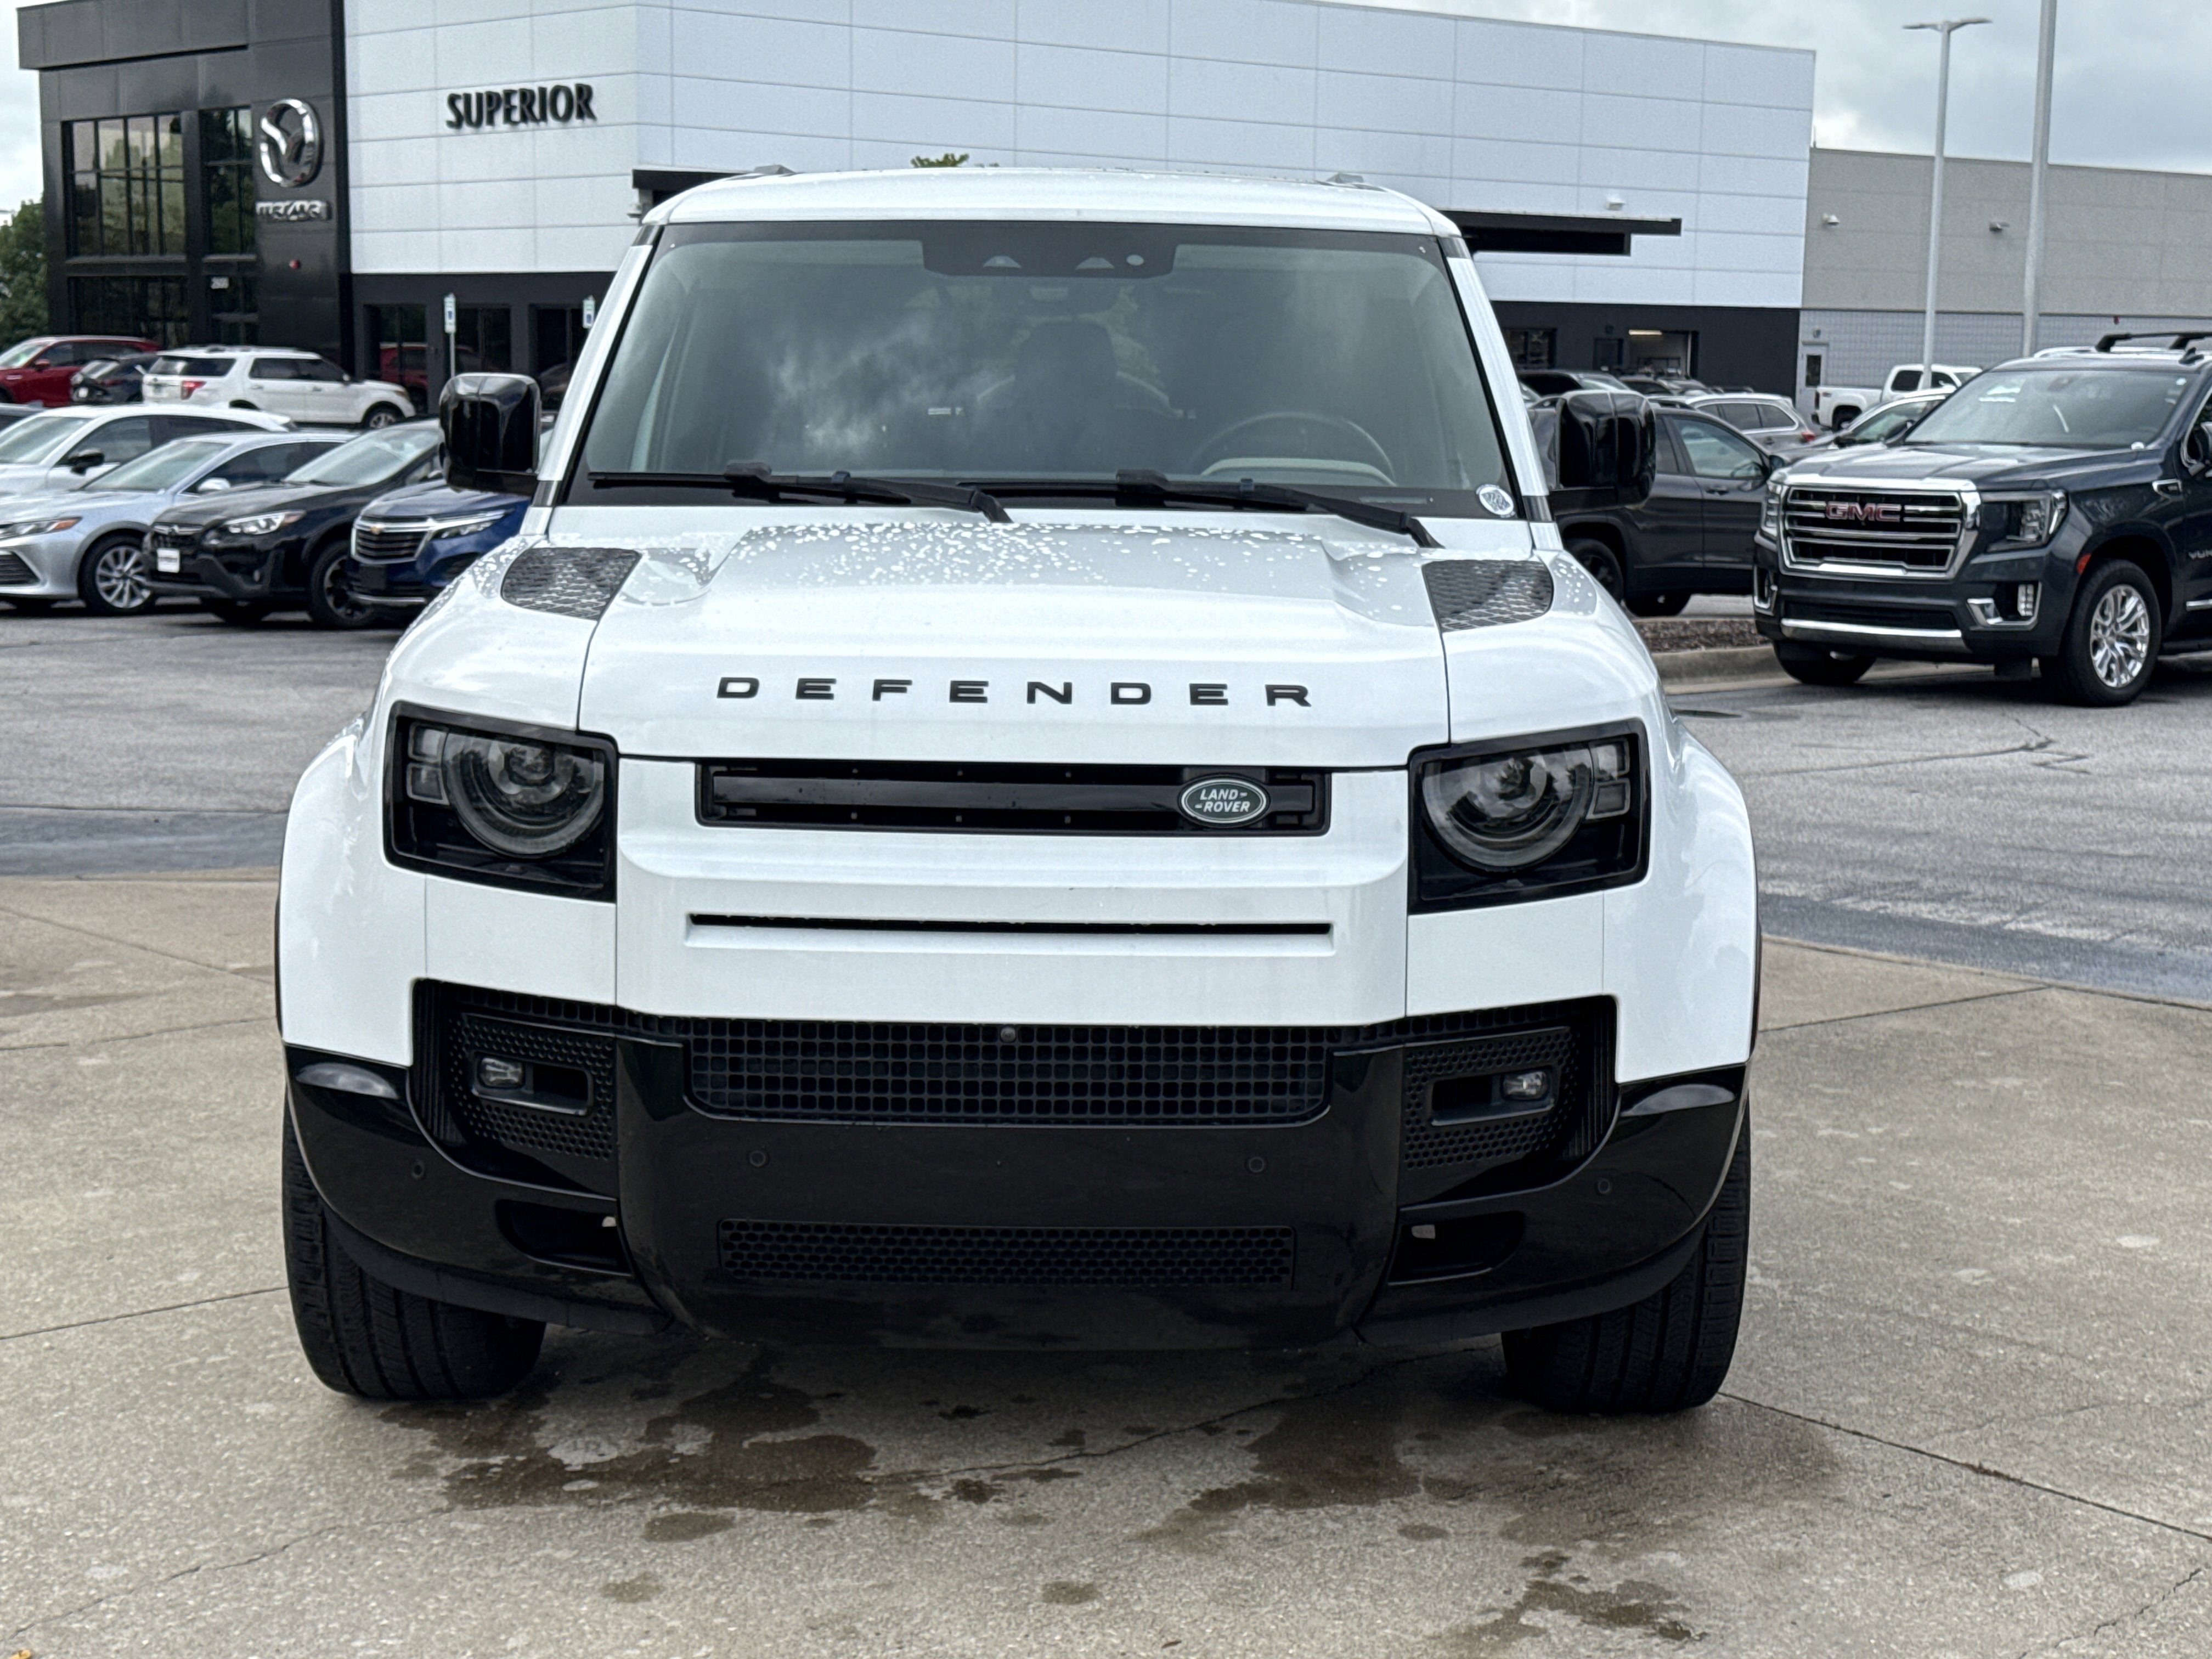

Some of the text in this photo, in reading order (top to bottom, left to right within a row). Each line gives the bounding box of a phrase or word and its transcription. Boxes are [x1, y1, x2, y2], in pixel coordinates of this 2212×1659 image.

[445, 83, 597, 129] SUPERIOR
[1826, 501, 1901, 522] GMC
[717, 677, 1311, 707] DEFENDER
